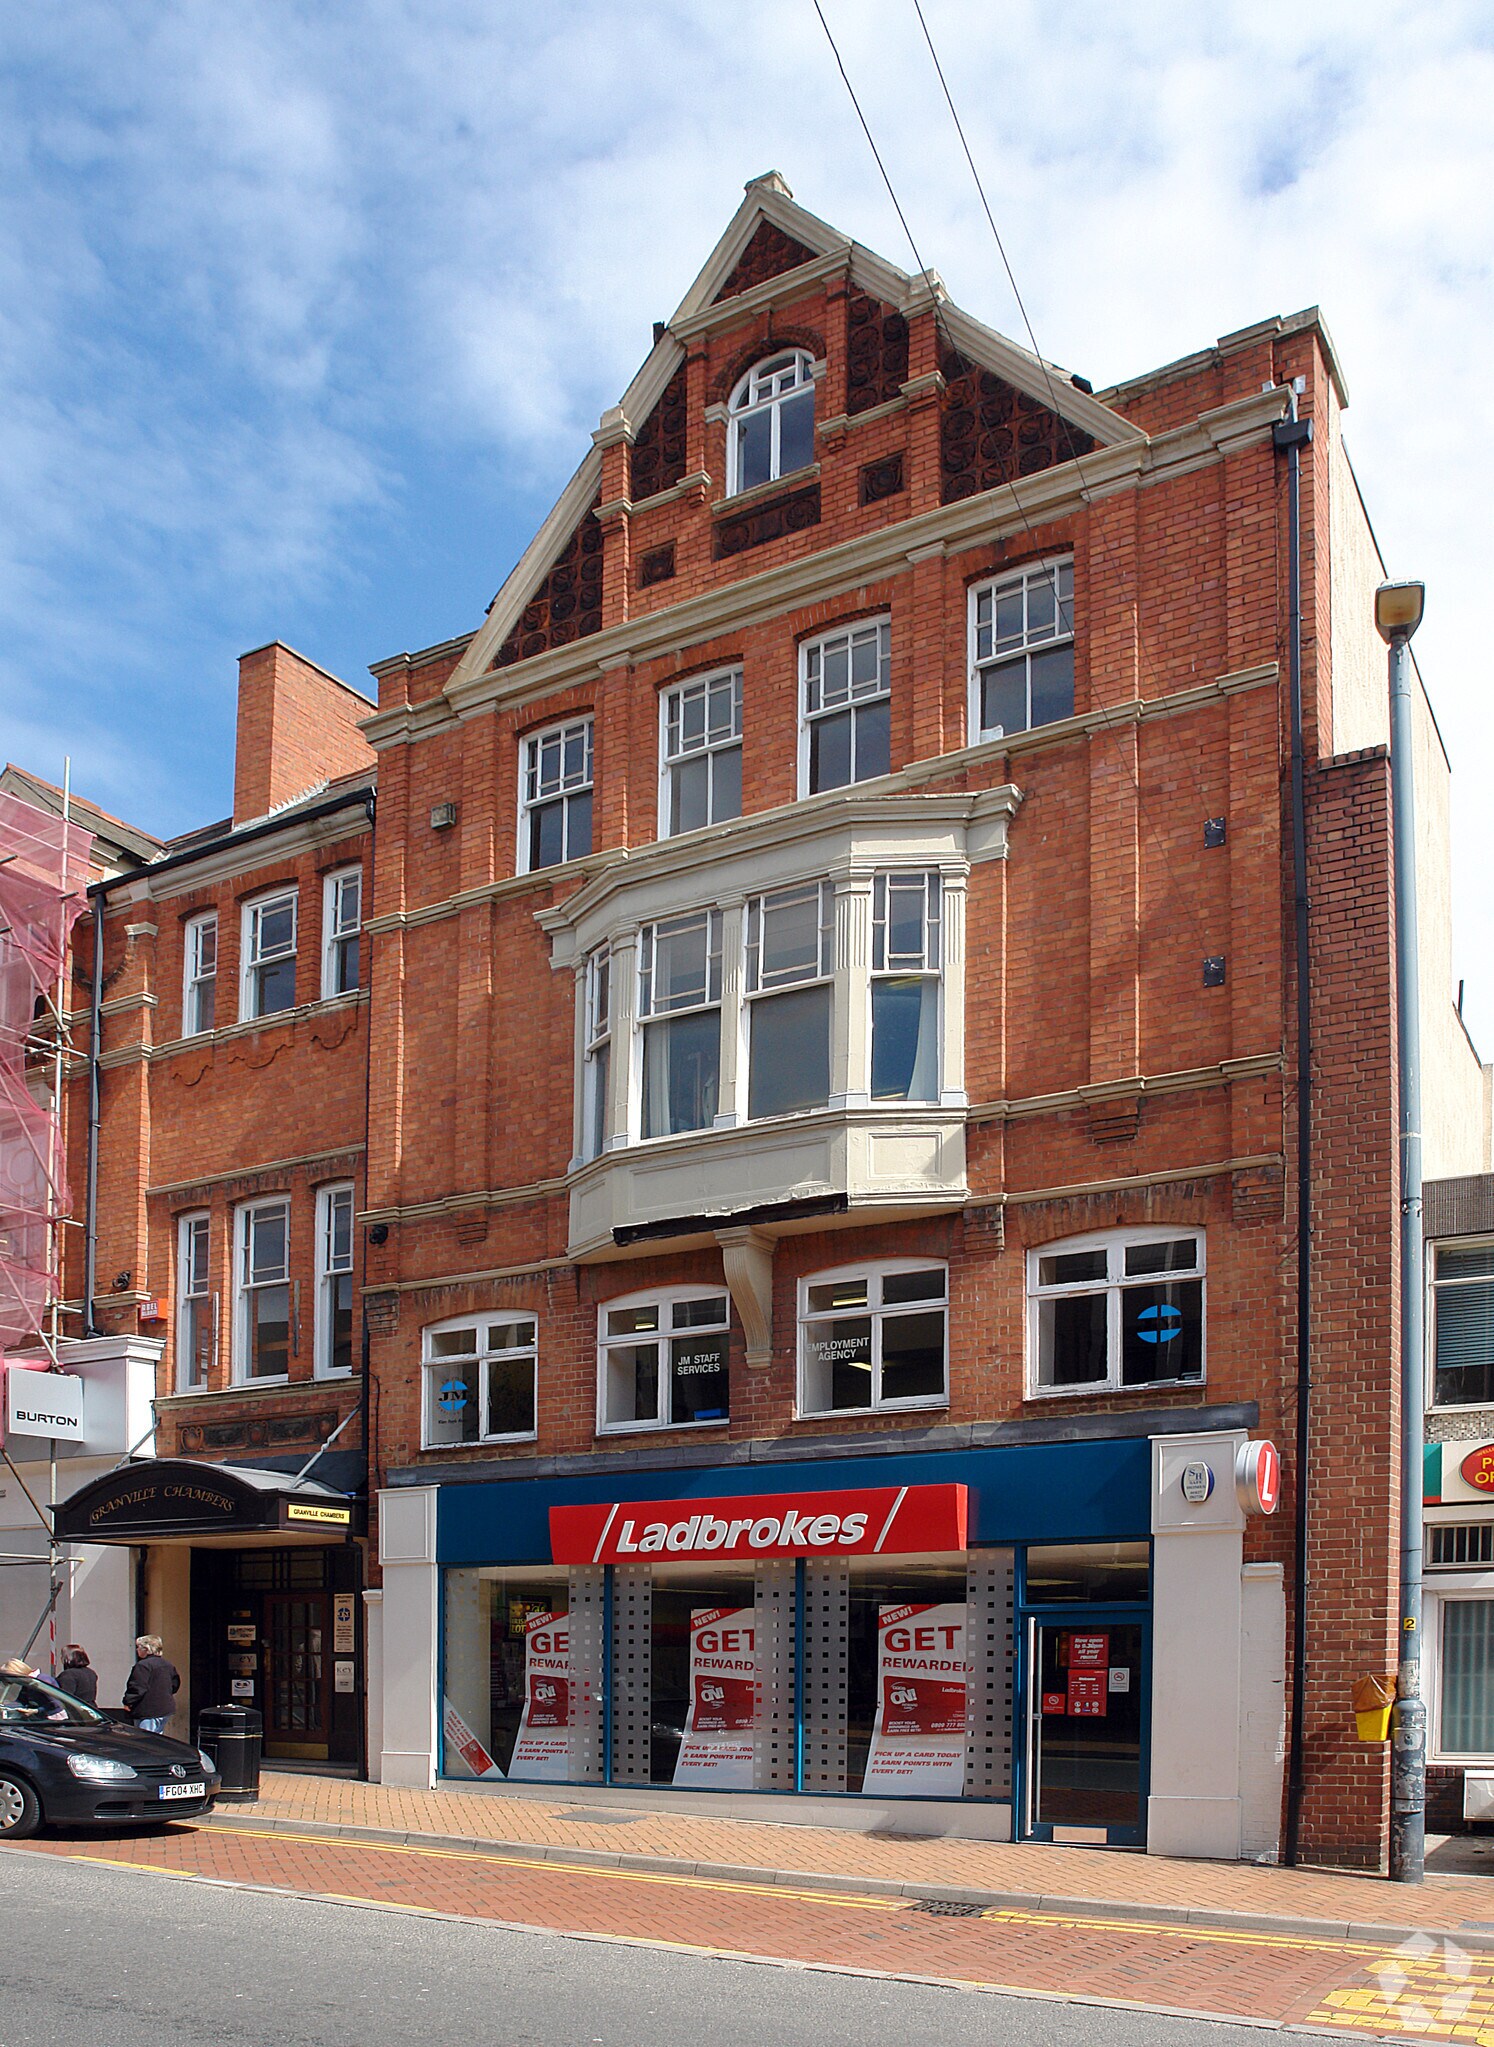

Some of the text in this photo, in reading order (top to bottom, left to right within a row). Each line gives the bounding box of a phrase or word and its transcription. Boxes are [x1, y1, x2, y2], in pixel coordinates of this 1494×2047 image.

[806, 1337, 870, 1353] EMPLOYMENT
[678, 1353, 720, 1366] JM STAFF
[818, 1349, 857, 1361] AGENCY
[677, 1363, 720, 1376] SERVICES
[16, 1410, 78, 1427] BURTON
[1482, 1457, 1494, 1469] P
[91, 1485, 235, 1522] GRANVILLE CHAMBERS
[293, 1508, 345, 1519] GRANVILLE CHAMBERS
[615, 1510, 869, 1553] Ladbrokes
[528, 1613, 553, 1629] NEW!
[693, 1610, 721, 1627] NEW!
[882, 1606, 913, 1625] NEW!
[1405, 1618, 1415, 1629] 2
[530, 1631, 569, 1654] GE
[884, 1625, 963, 1653] GET
[694, 1657, 757, 1672] REWARD
[700, 1686, 725, 1702] ON!
[890, 1688, 918, 1705] ON!
[166, 1785, 188, 1796] FG04
